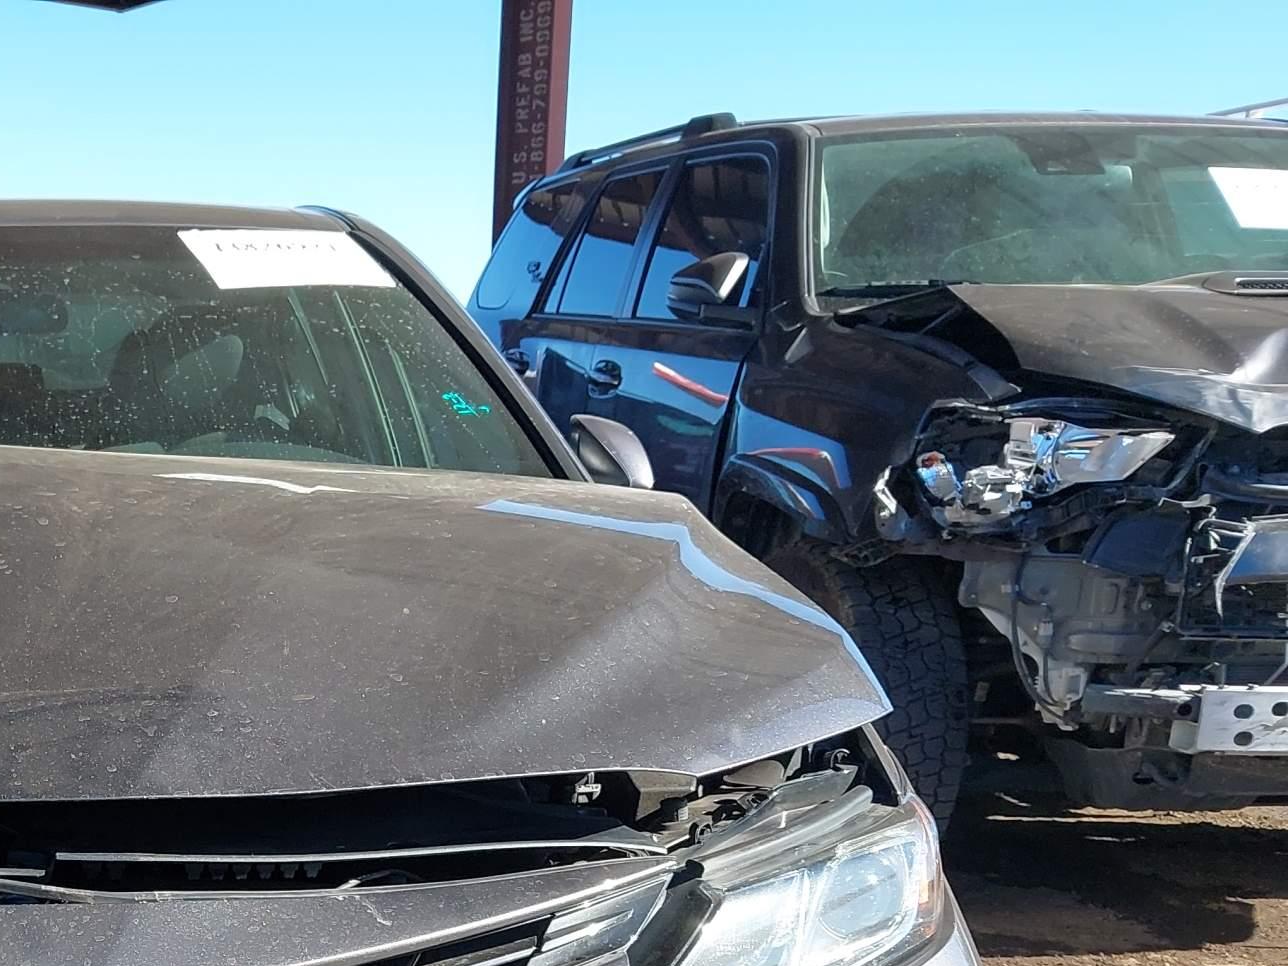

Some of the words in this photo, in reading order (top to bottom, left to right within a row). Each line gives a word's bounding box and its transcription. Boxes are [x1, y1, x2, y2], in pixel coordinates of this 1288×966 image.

[518, 0, 536, 42] INC.
[515, 54, 532, 133] PREFAB
[512, 144, 528, 184] U.S.
